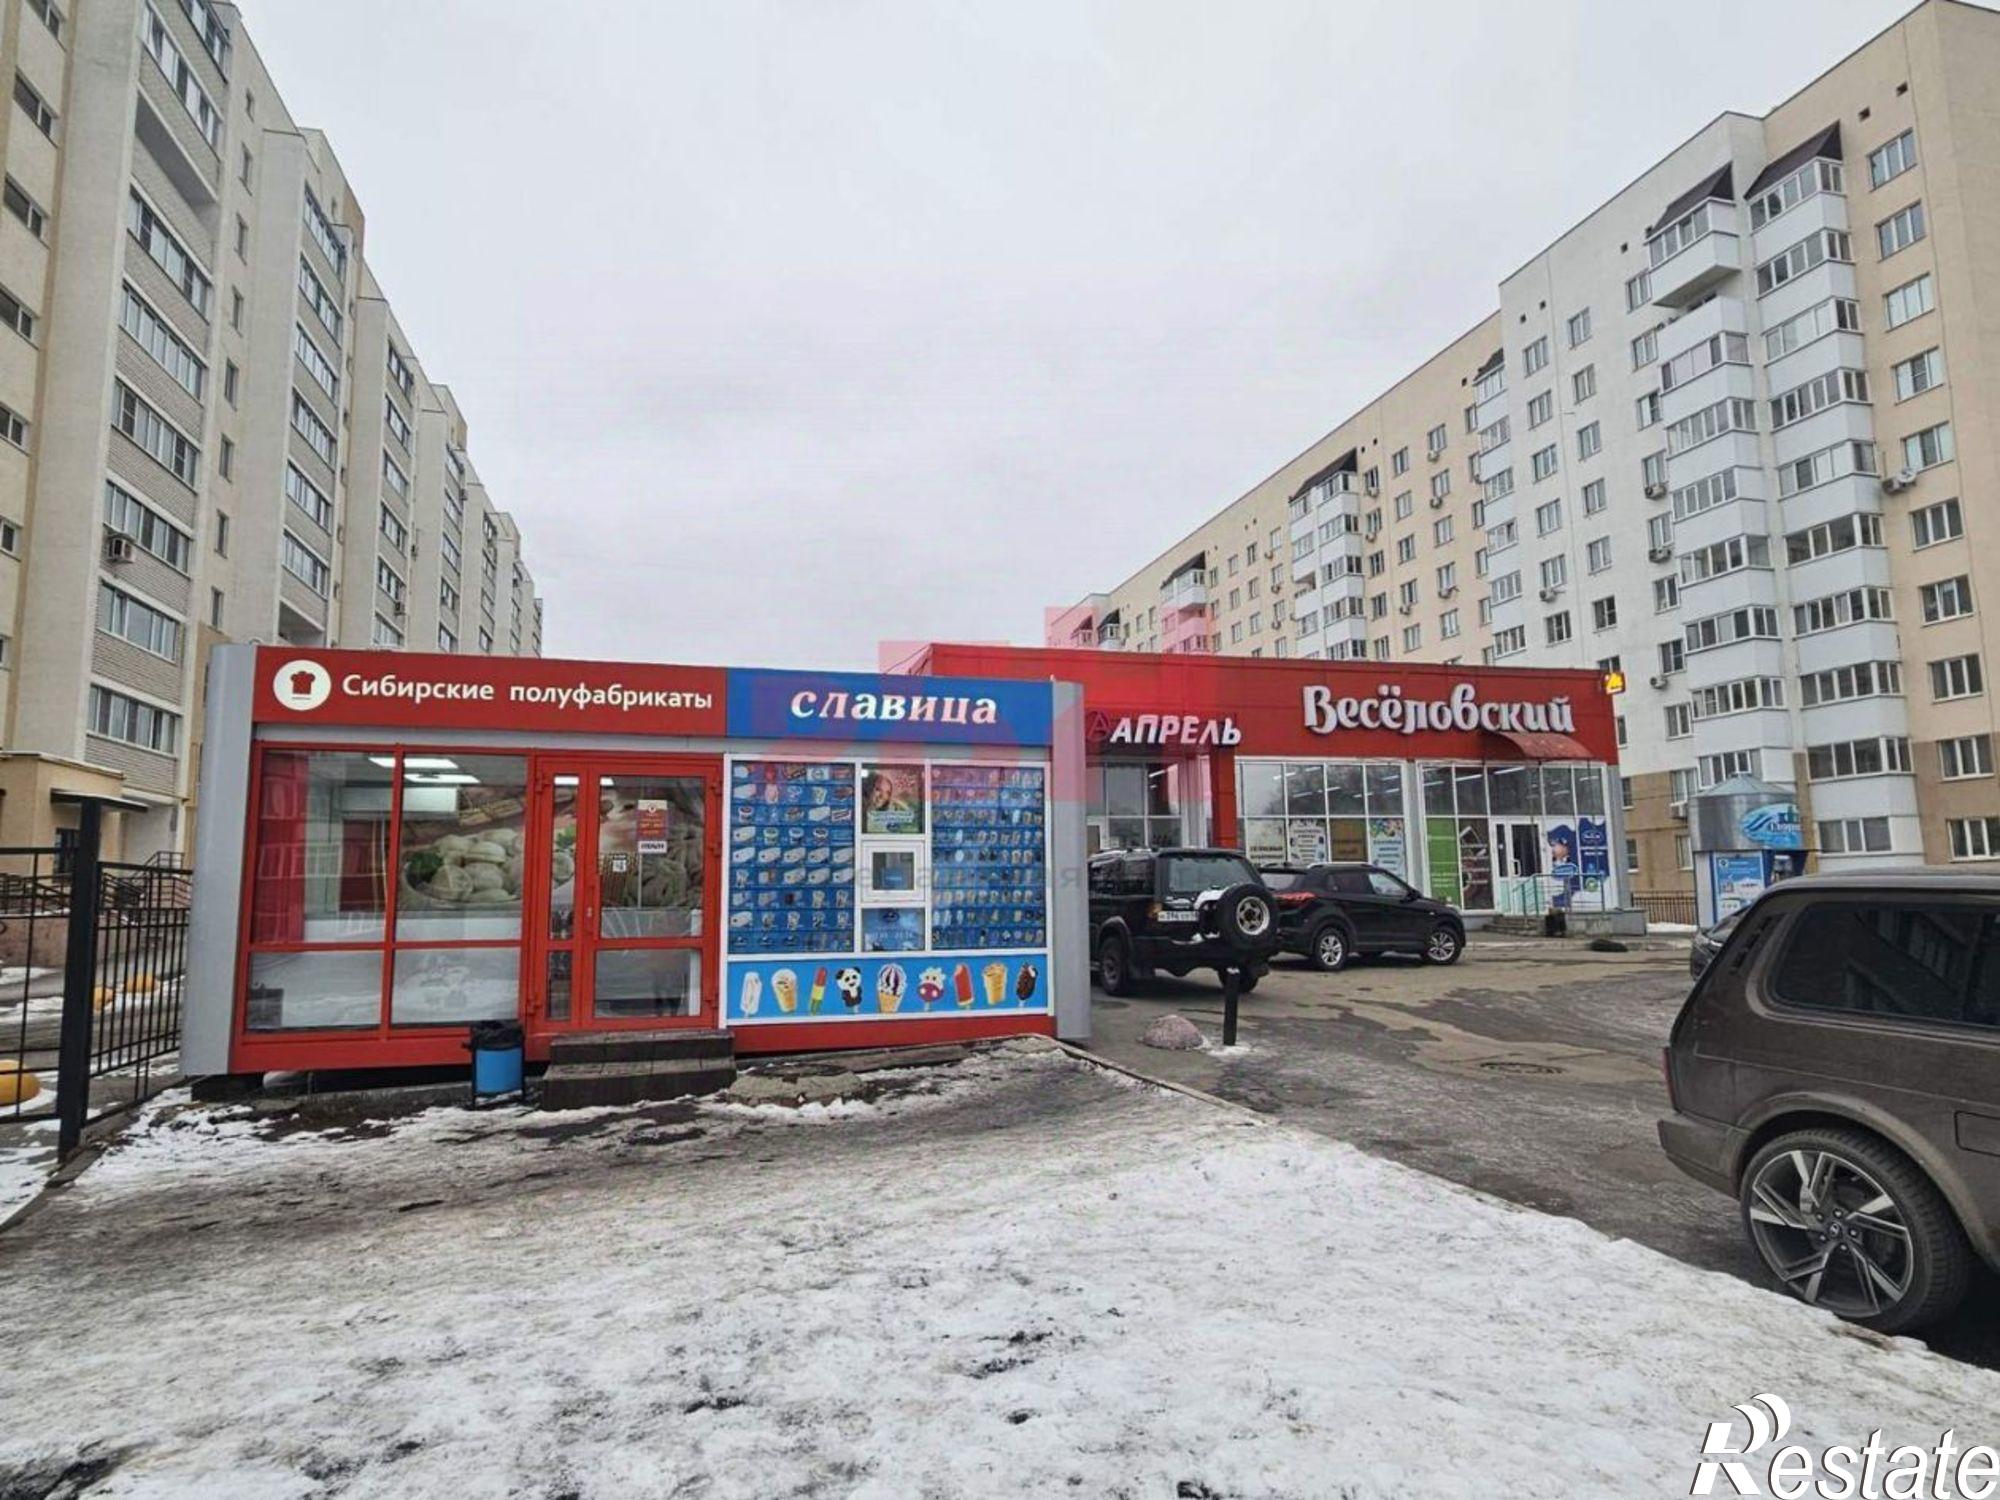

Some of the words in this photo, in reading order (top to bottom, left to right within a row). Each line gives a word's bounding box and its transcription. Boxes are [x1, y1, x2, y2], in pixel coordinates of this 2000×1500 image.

[342, 674, 495, 703] Сибирские
[510, 682, 713, 711] полуфабрикаты
[790, 690, 998, 725] славица
[1303, 683, 1575, 734] Весёловский
[1109, 714, 1242, 745] АПРЕЛЬ
